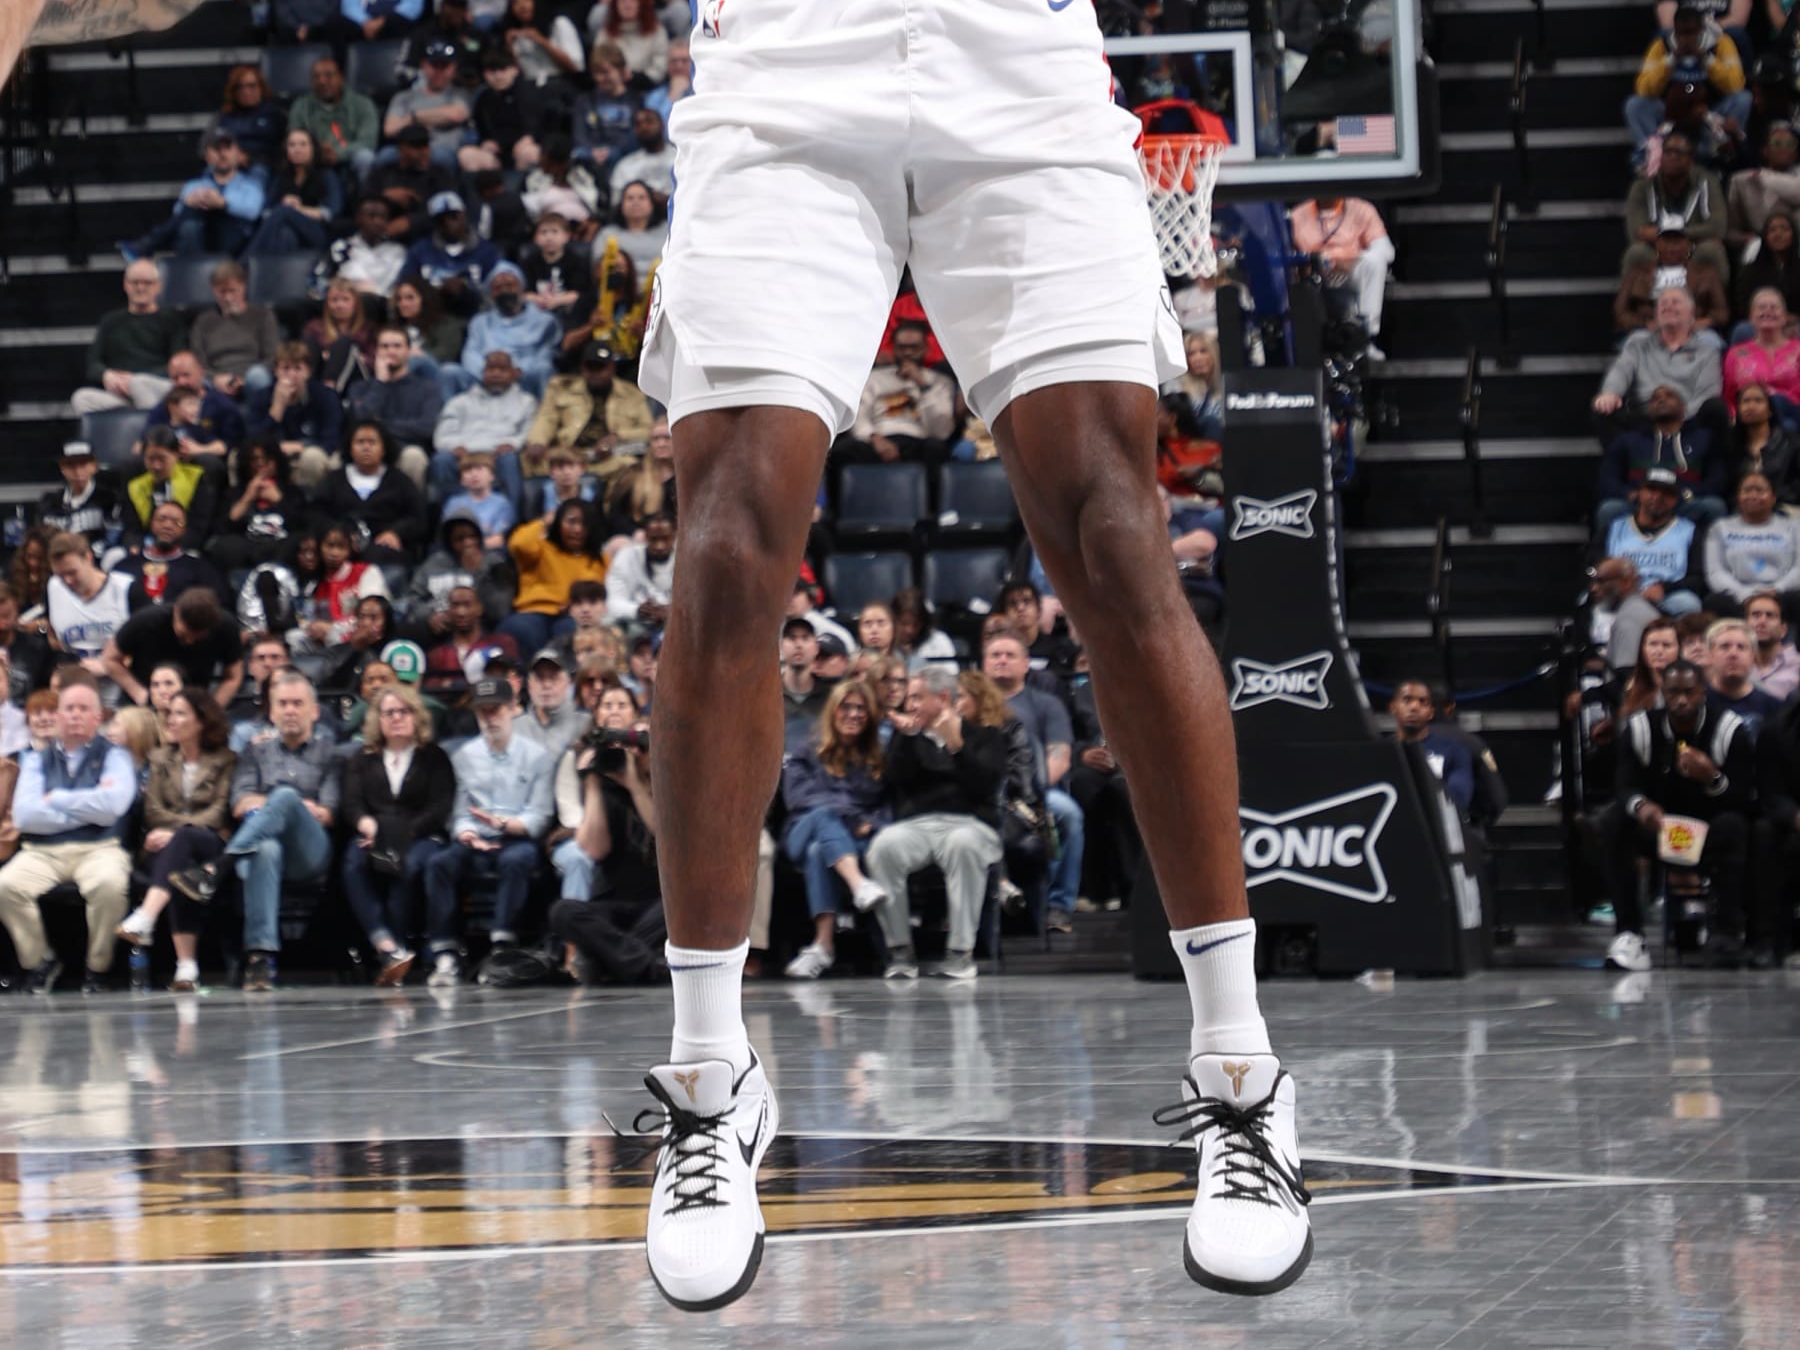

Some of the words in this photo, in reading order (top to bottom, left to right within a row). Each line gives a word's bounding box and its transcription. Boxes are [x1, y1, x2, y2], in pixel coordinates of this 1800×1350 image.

[1242, 505, 1305, 527] SONIC
[1242, 671, 1318, 694] SONIC
[1240, 824, 1366, 869] ONIC
